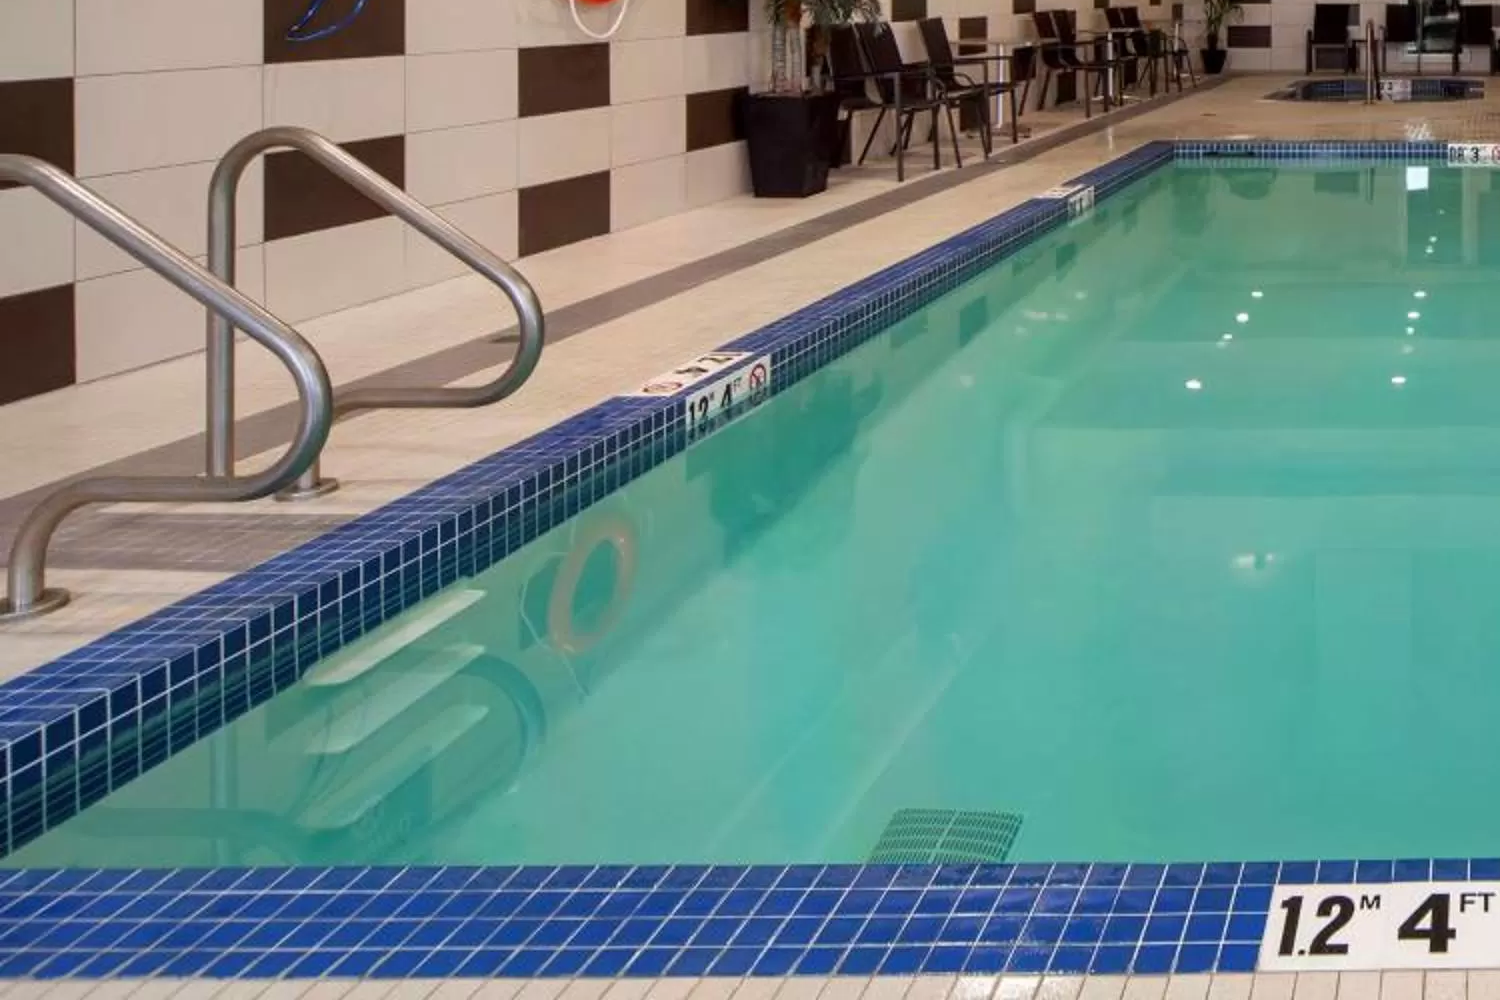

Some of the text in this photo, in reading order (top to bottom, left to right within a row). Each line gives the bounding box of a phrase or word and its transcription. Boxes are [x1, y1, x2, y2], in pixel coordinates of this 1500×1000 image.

[1278, 891, 1497, 956] 1.2 M 4 FT
